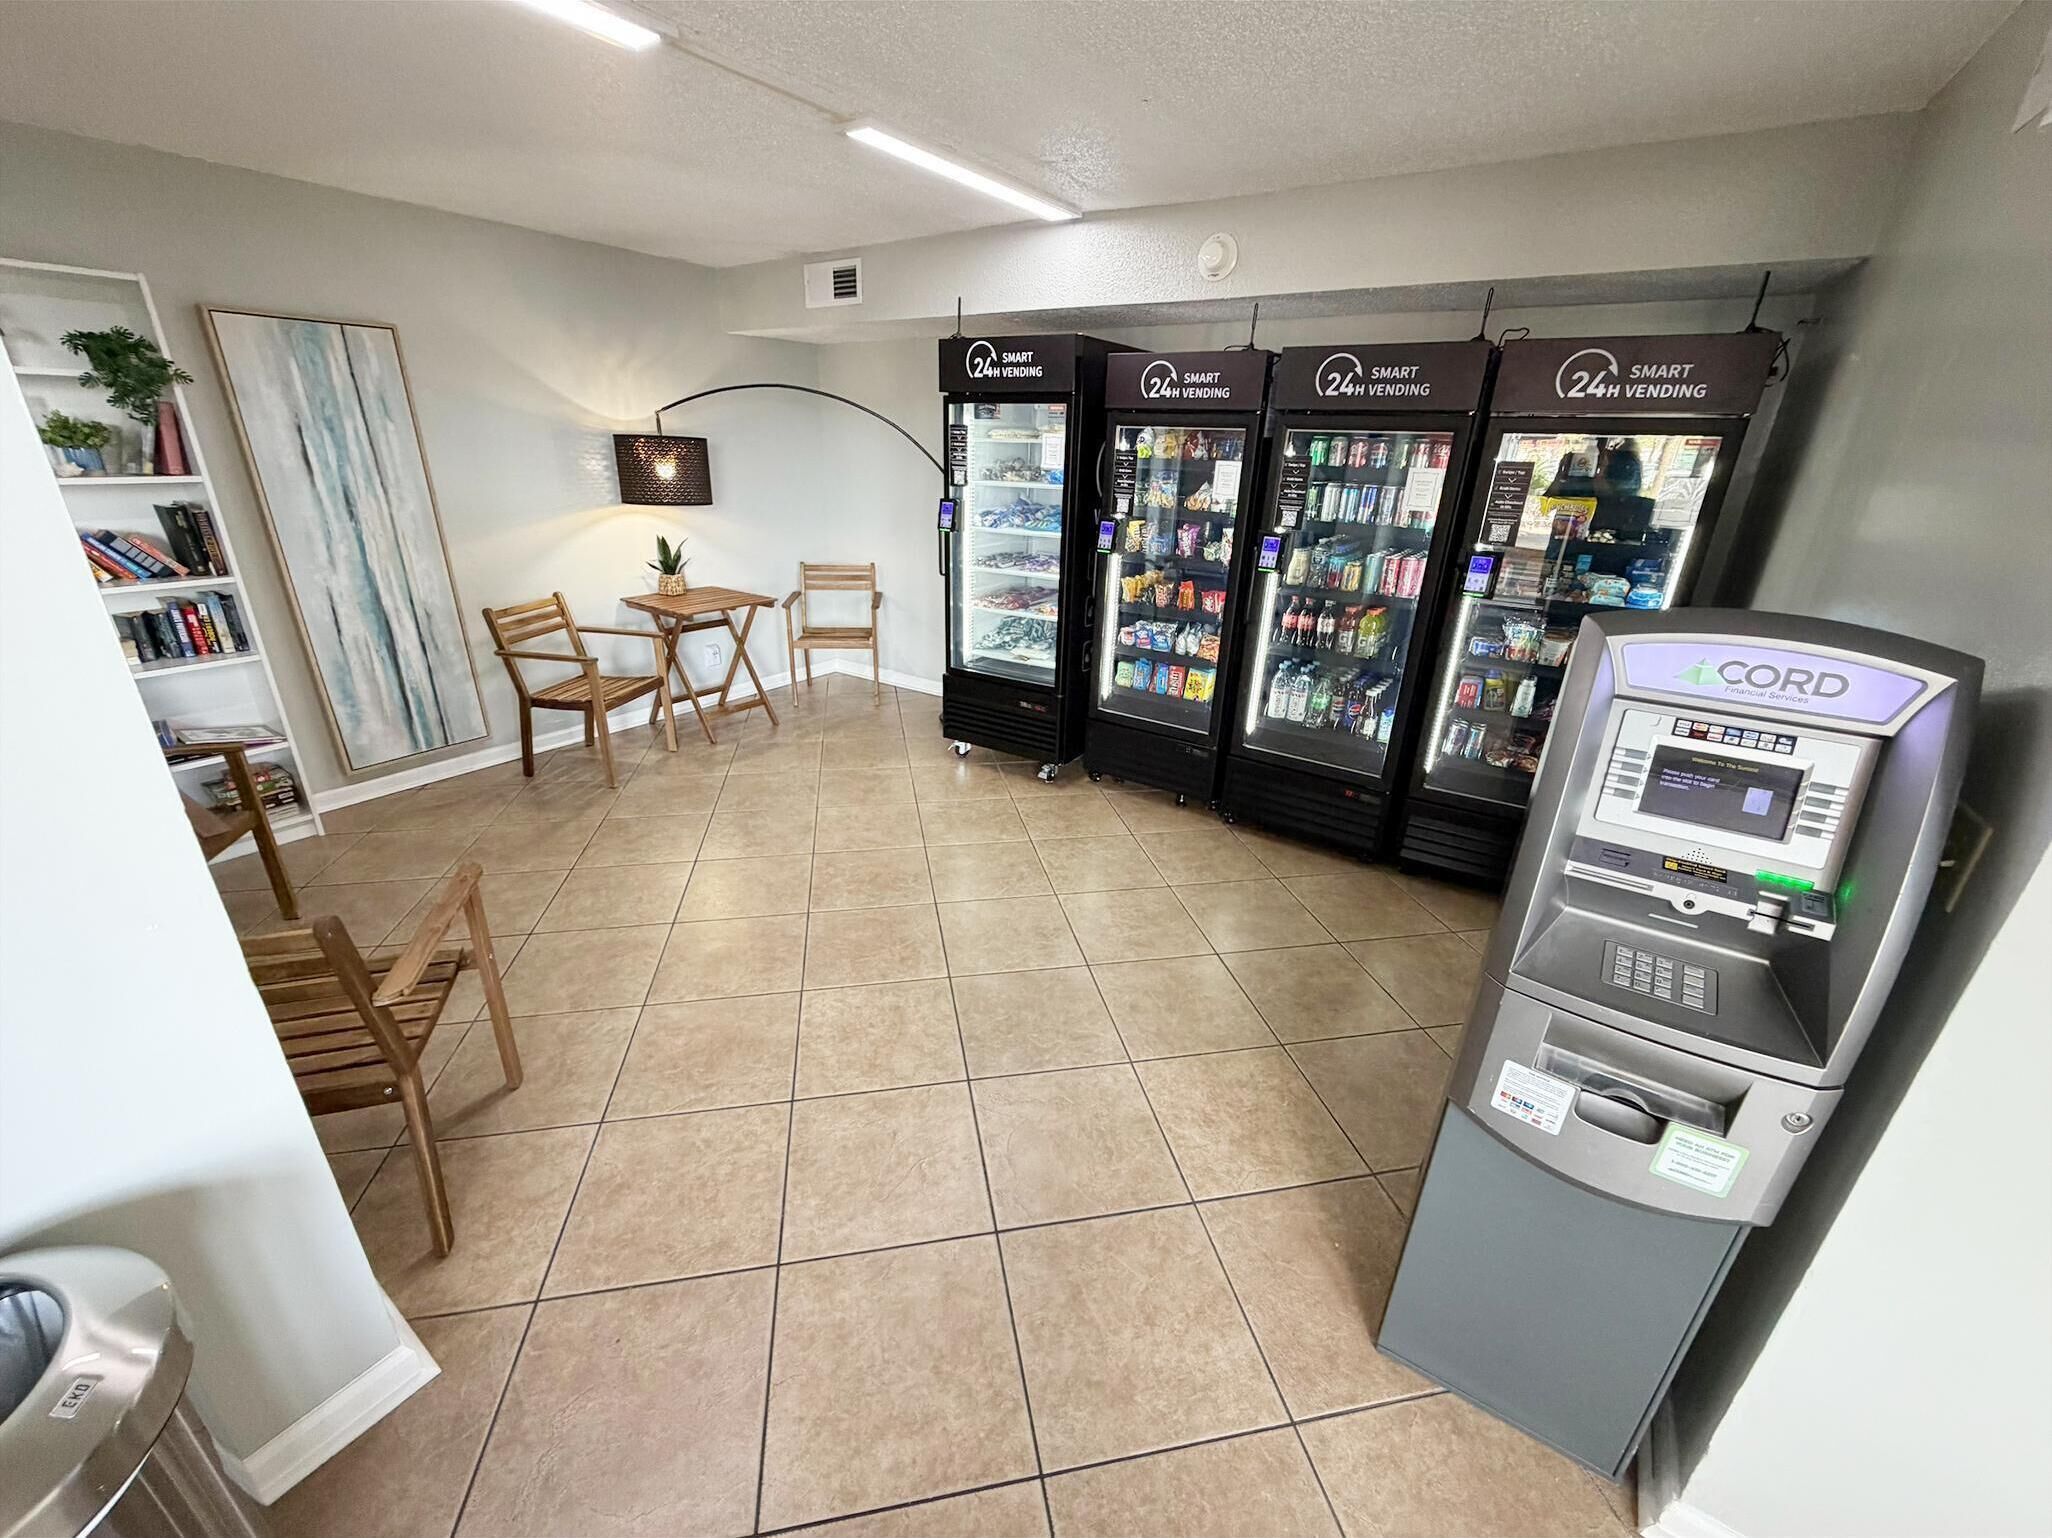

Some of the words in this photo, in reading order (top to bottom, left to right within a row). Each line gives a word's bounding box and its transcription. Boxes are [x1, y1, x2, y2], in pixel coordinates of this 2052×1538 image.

[1002, 351, 1034, 363] SMART
[1001, 366, 1043, 378] VENDING
[1370, 366, 1420, 379] SMART
[1629, 363, 1695, 379] SMART
[1183, 372, 1221, 384] SMART
[1182, 387, 1231, 399] VENDING
[1368, 383, 1431, 396] VENDING
[1625, 383, 1708, 399] VENDING
[1724, 685, 1767, 698] Financial
[1768, 690, 1809, 704] Services
[62, 1382, 91, 1410] EKO
